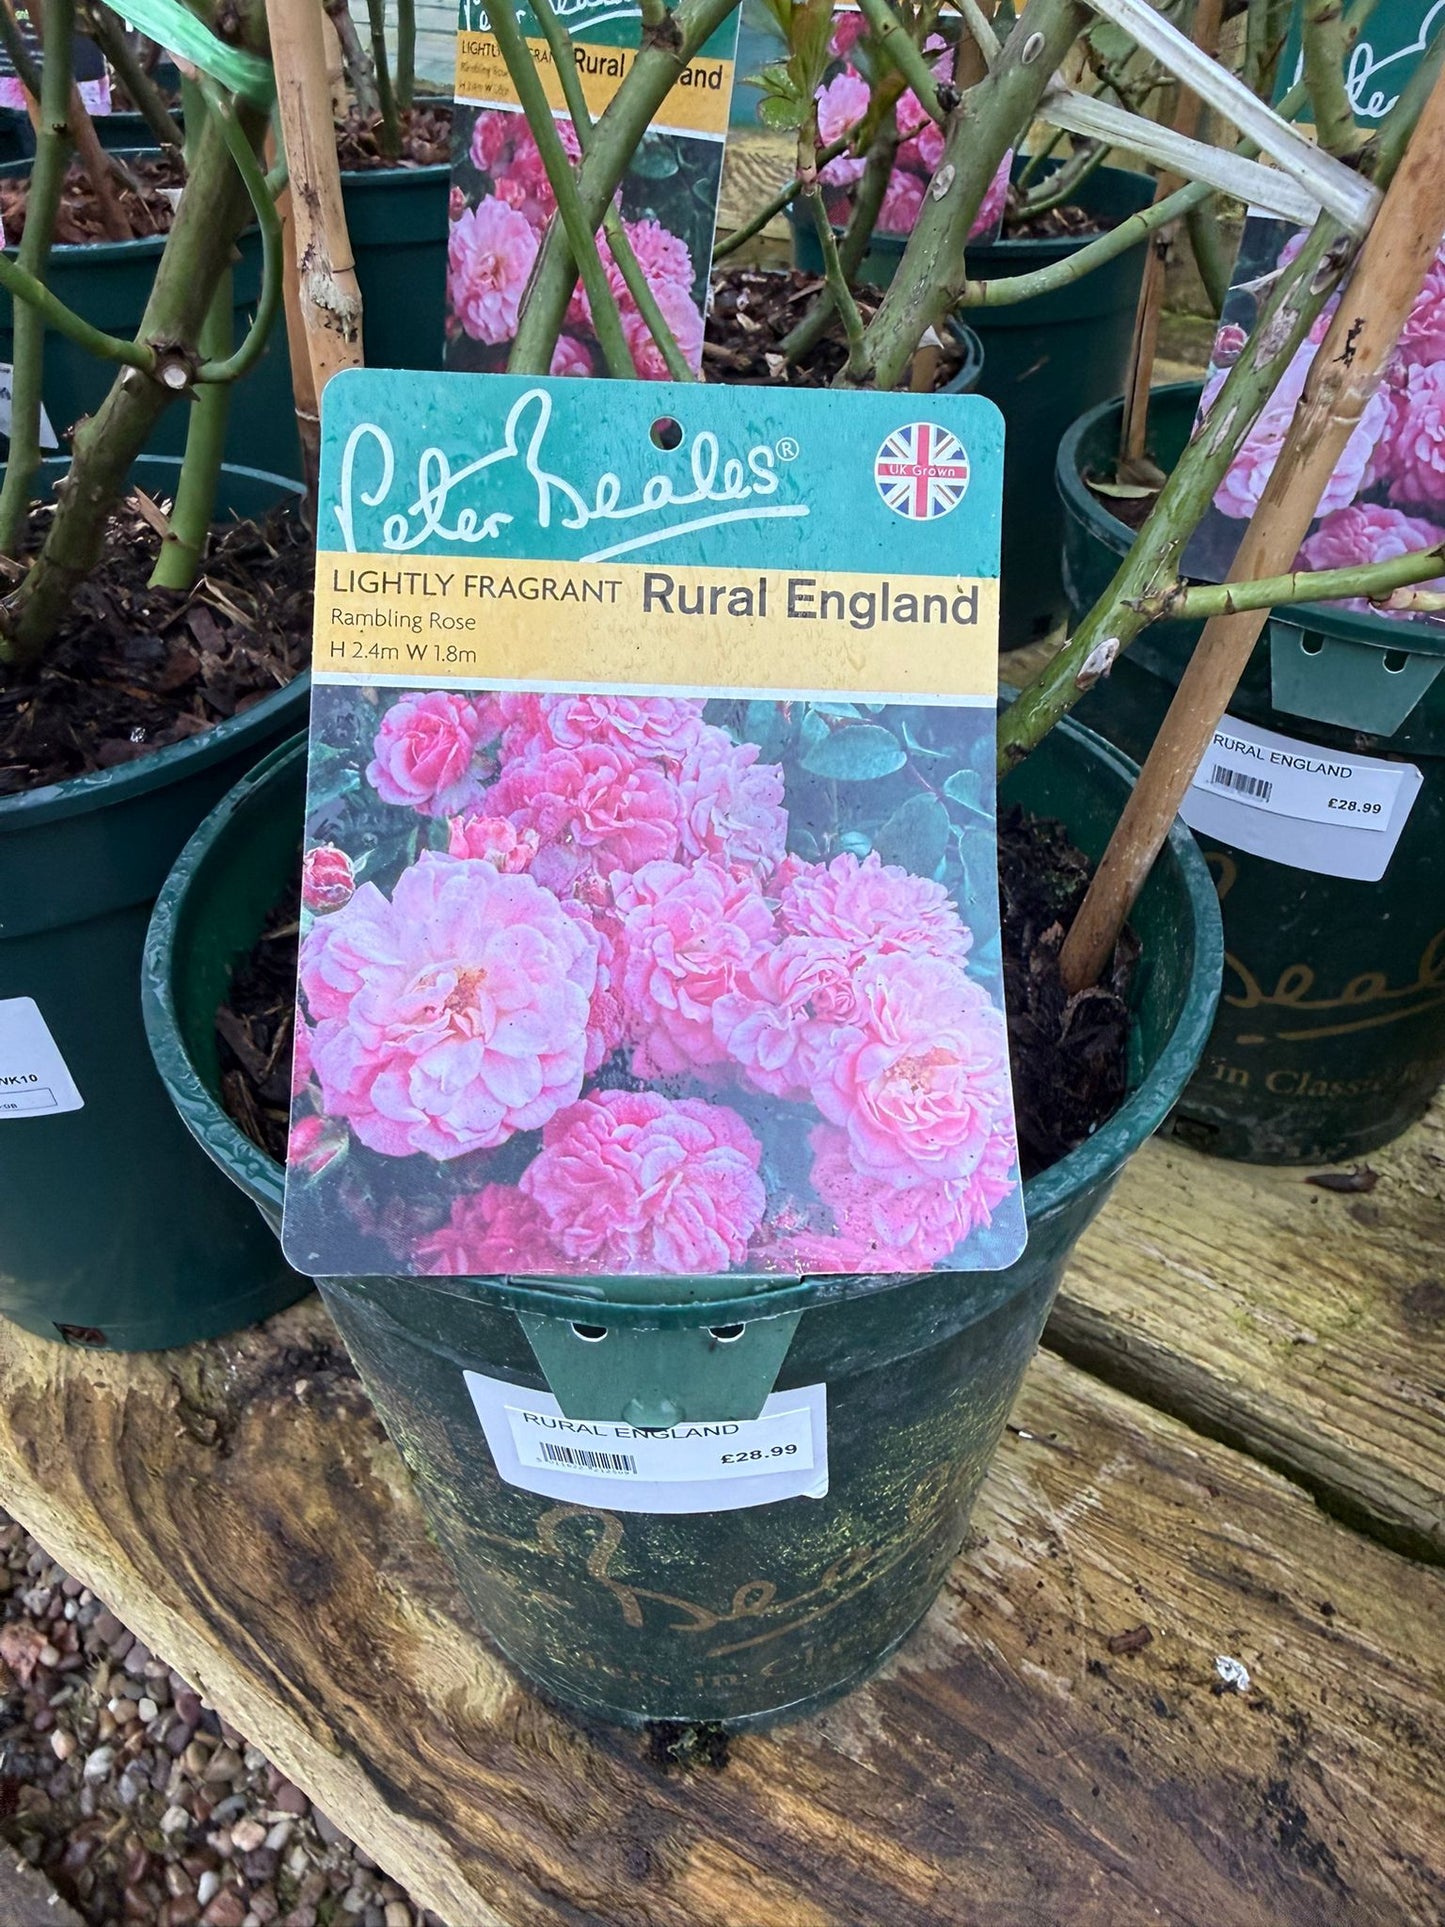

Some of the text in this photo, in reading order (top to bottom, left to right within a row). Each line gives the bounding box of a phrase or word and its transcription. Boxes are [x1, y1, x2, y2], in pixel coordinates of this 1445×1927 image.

[462, 40, 501, 58] LIGHTL
[574, 47, 625, 78] Rural
[889, 463, 956, 478] UK Grown
[334, 422, 514, 553] Peter
[332, 569, 623, 604] LIGHTLY FRAGRANT
[643, 572, 979, 631] Rural England
[331, 608, 476, 633] Rambling Rose
[330, 641, 477, 663] H 2.4m W 1.8m
[1213, 734, 1353, 779] RURAL ENGLAND
[1327, 797, 1382, 815] £28.99
[523, 1412, 740, 1440] RURAL ENGLAND
[721, 1443, 798, 1465] £28.99
